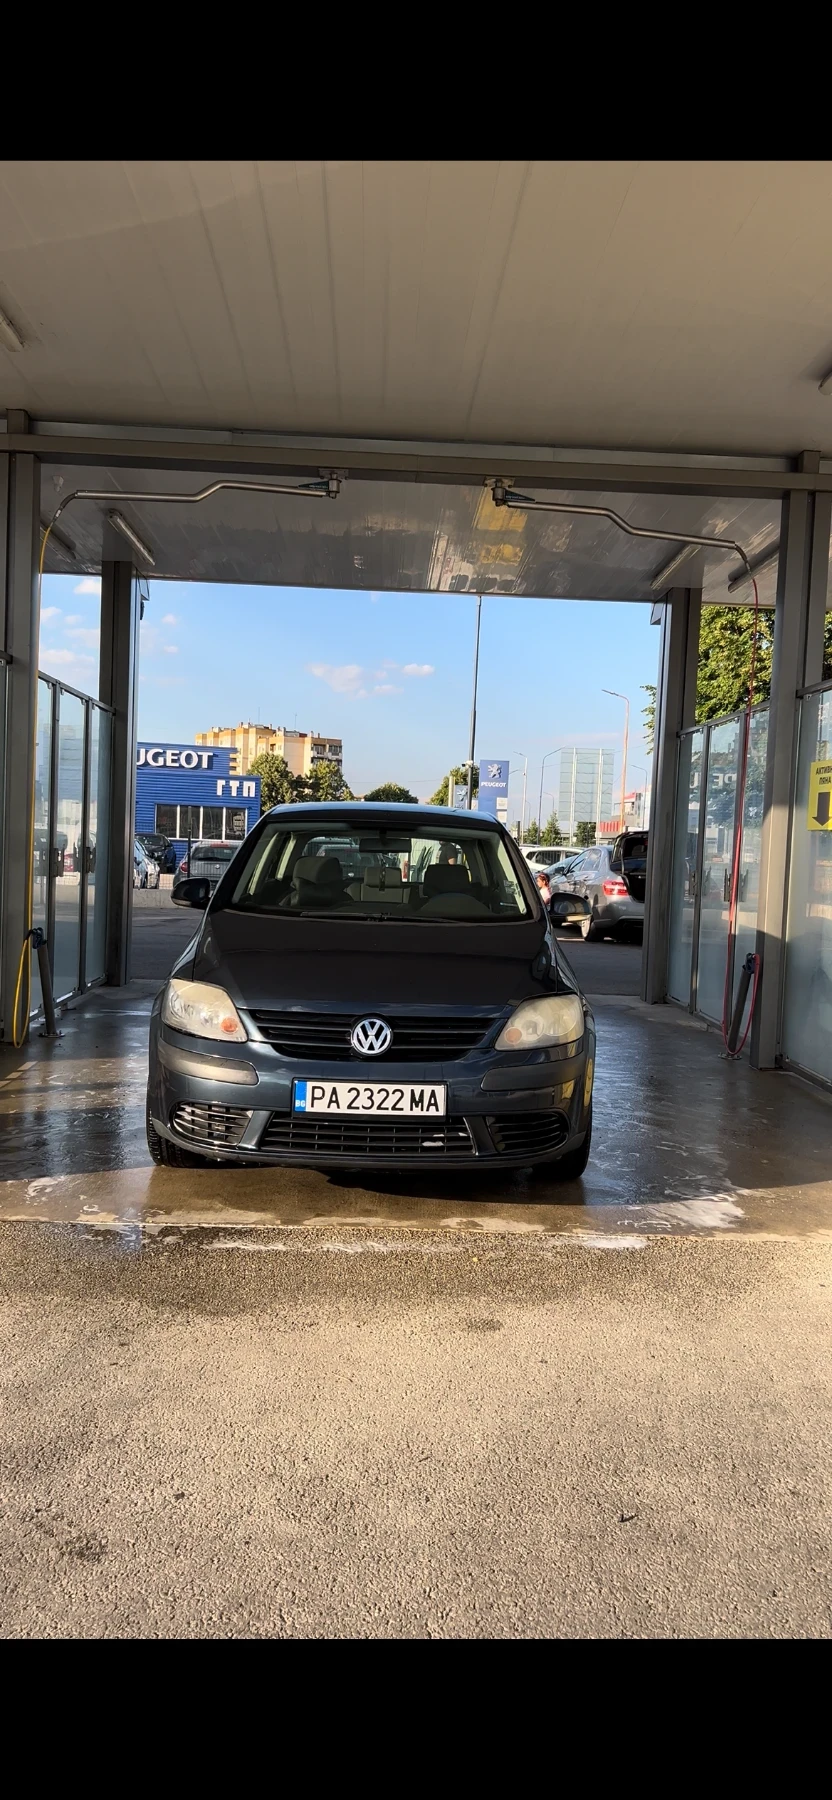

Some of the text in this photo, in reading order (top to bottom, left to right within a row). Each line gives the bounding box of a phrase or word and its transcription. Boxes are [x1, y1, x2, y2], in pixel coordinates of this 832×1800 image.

[216, 780, 256, 797] ГТП
[295, 1099, 306, 1108] BG
[310, 1085, 440, 1112] PA 2322 MA
